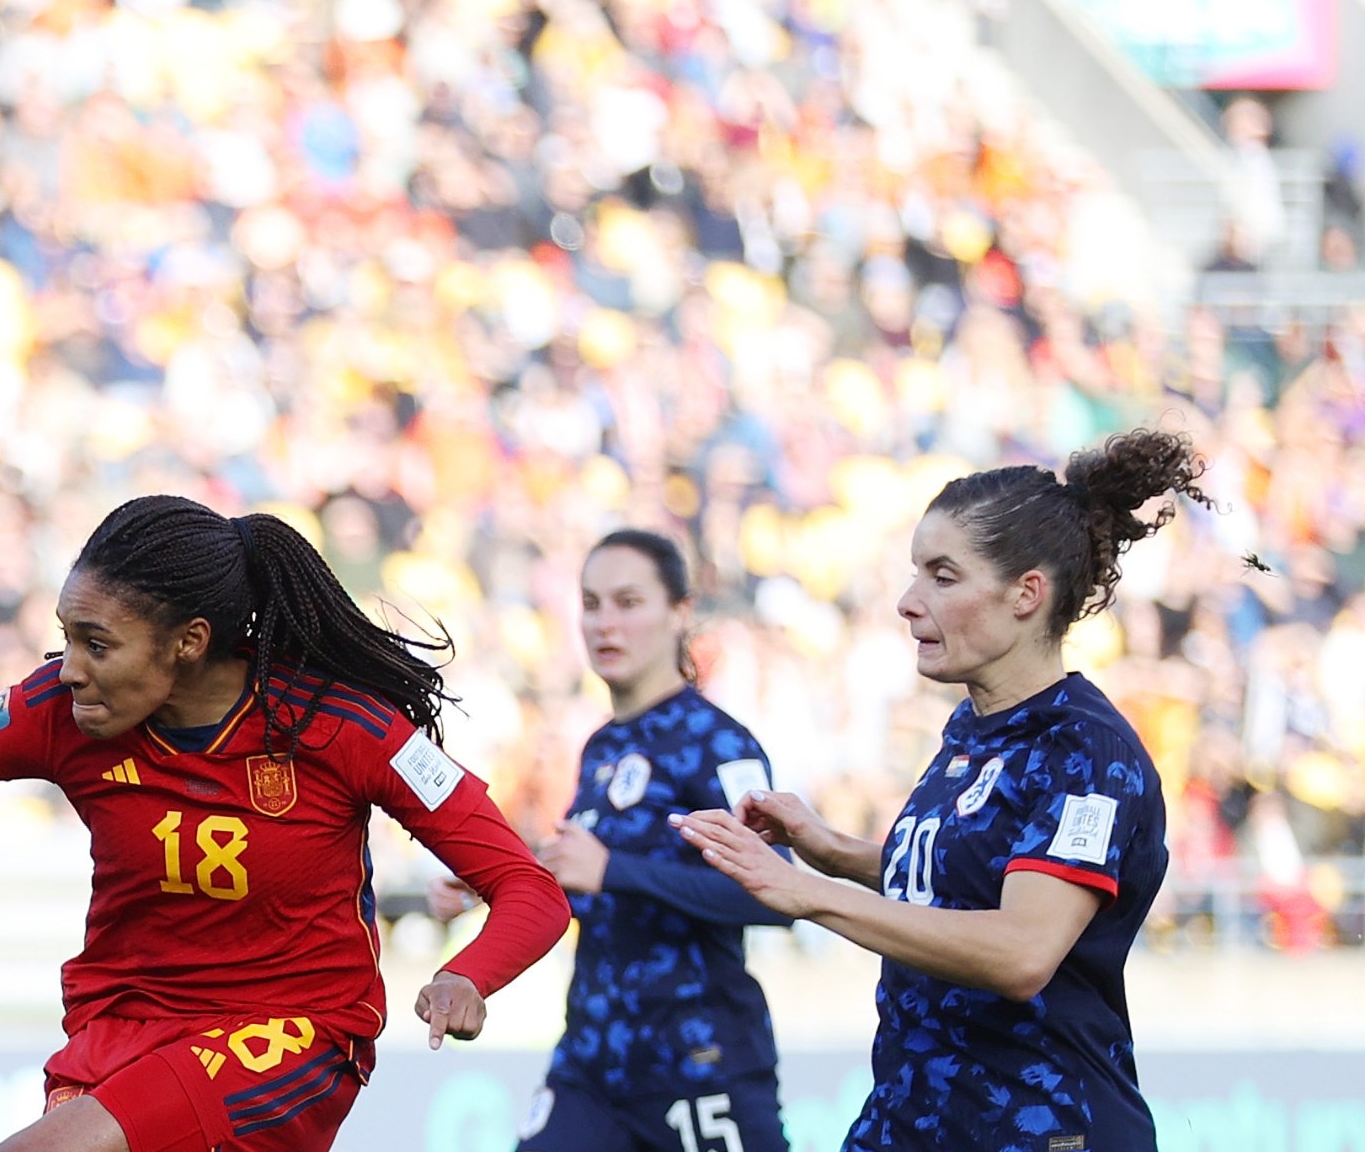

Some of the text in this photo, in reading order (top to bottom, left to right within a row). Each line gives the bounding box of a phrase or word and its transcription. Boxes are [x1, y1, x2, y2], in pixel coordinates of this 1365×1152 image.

[413, 749, 435, 775] UNITES
[152, 810, 249, 900] 18
[883, 816, 940, 906] 20
[201, 1017, 316, 1074] 8
